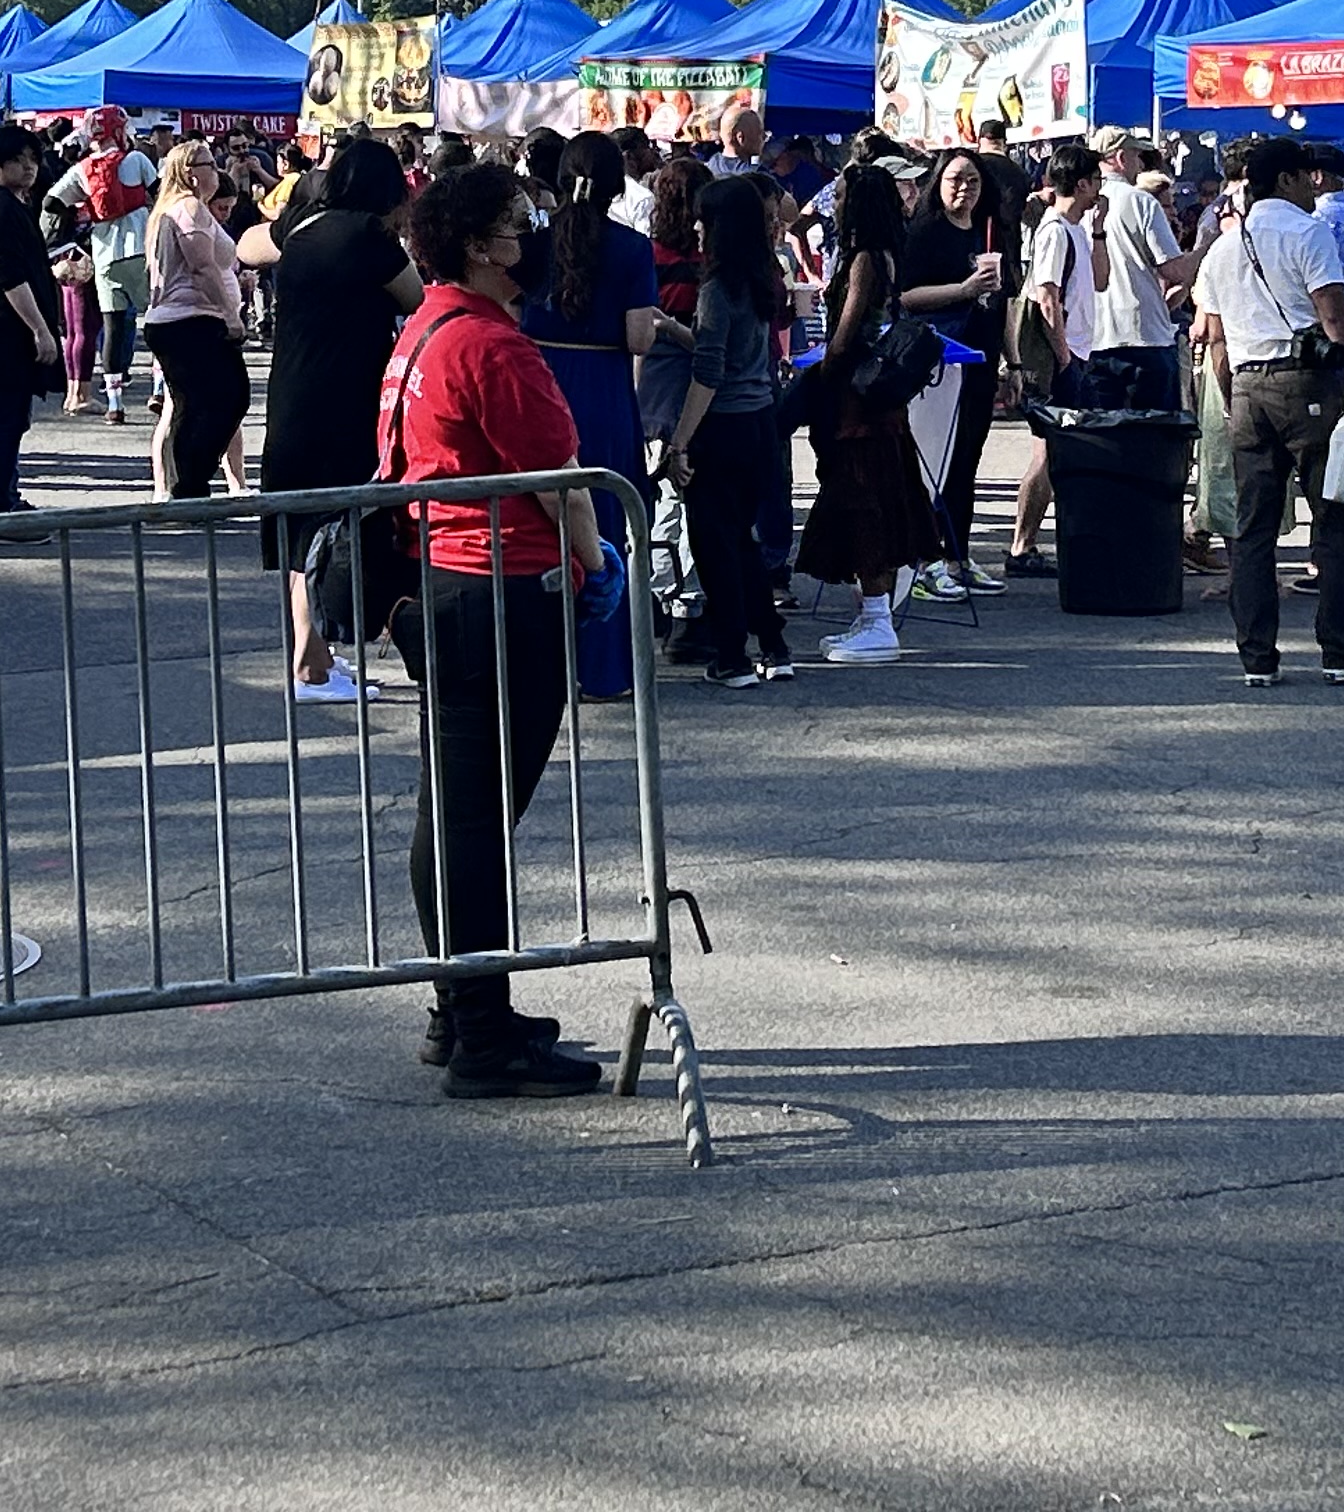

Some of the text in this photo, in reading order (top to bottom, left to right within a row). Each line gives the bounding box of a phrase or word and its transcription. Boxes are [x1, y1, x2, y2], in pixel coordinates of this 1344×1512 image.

[1281, 55, 1301, 75] LA
[650, 66, 675, 87] THE
[253, 115, 287, 134] CAKE
